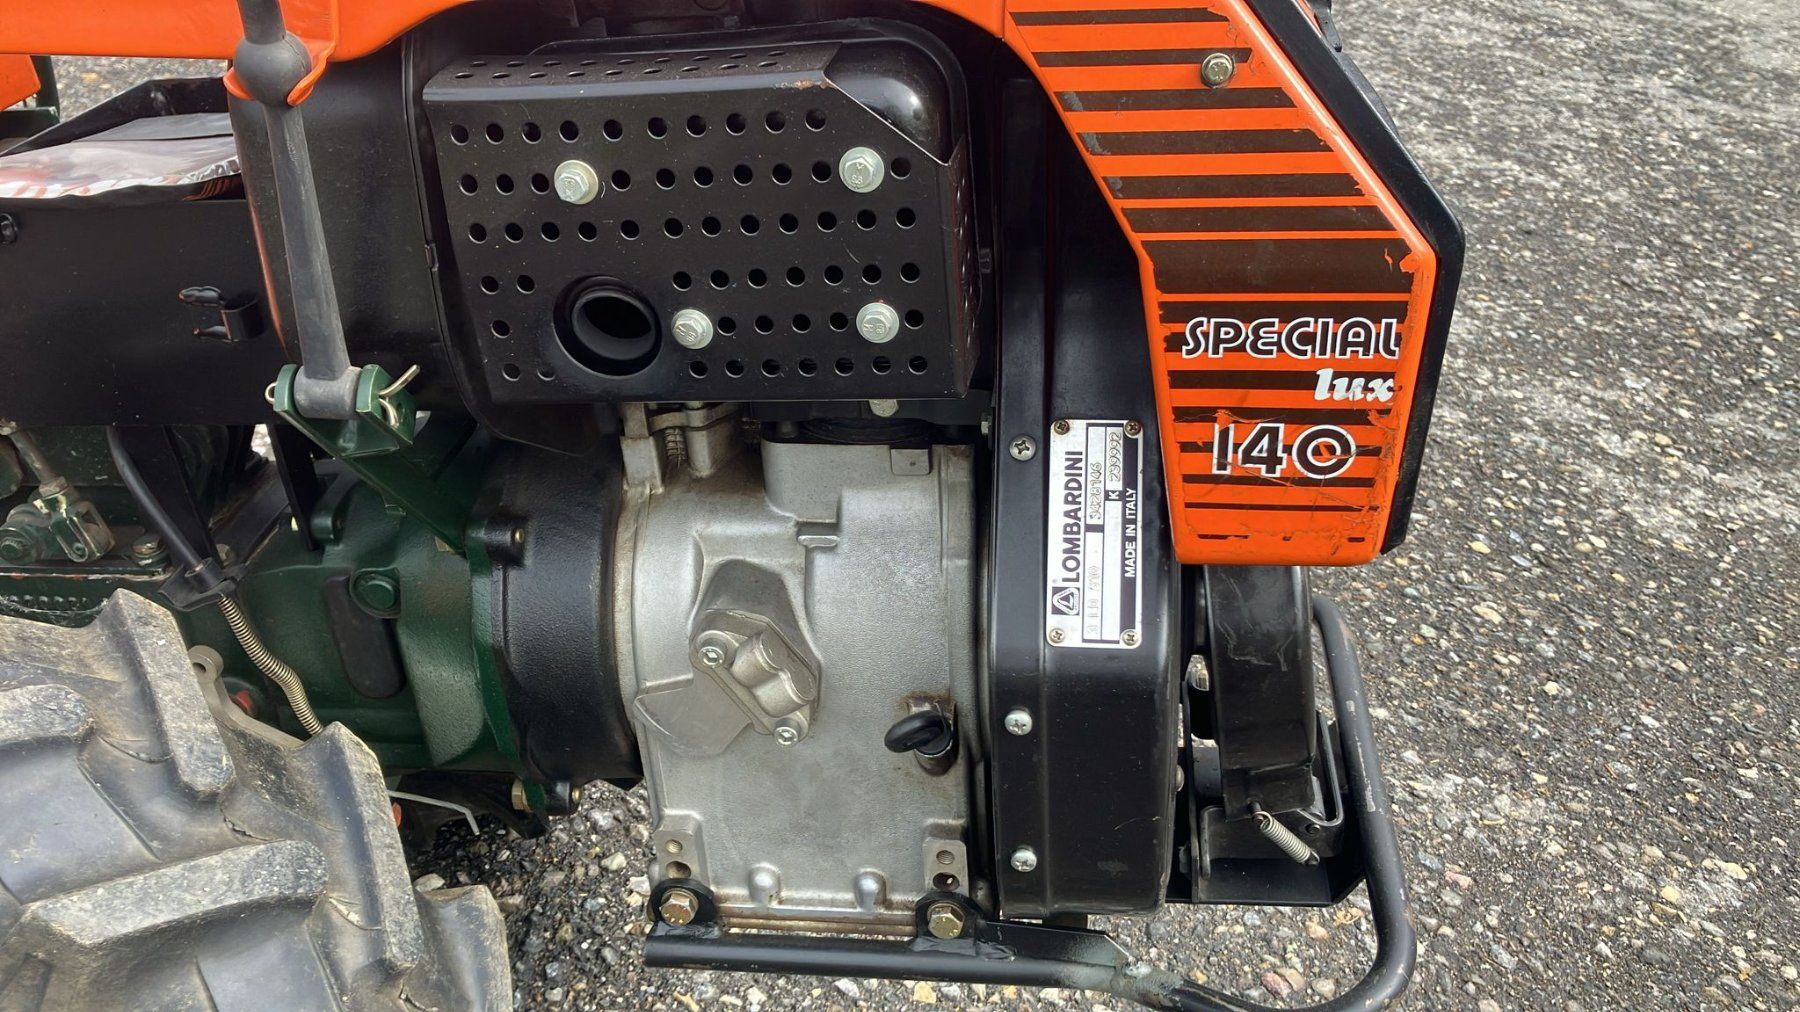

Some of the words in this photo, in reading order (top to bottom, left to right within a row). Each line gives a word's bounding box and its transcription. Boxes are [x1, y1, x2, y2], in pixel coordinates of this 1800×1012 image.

[1181, 316, 1399, 360] SPECIAL
[1313, 368, 1395, 403] lux
[1107, 431, 1122, 482] 239992
[1211, 422, 1357, 480] 140
[1108, 490, 1119, 500] K
[1125, 487, 1137, 519] ITALY
[1061, 451, 1083, 583] LOMBARDINI
[1125, 524, 1136, 537] IN
[1124, 541, 1136, 578] MADE
